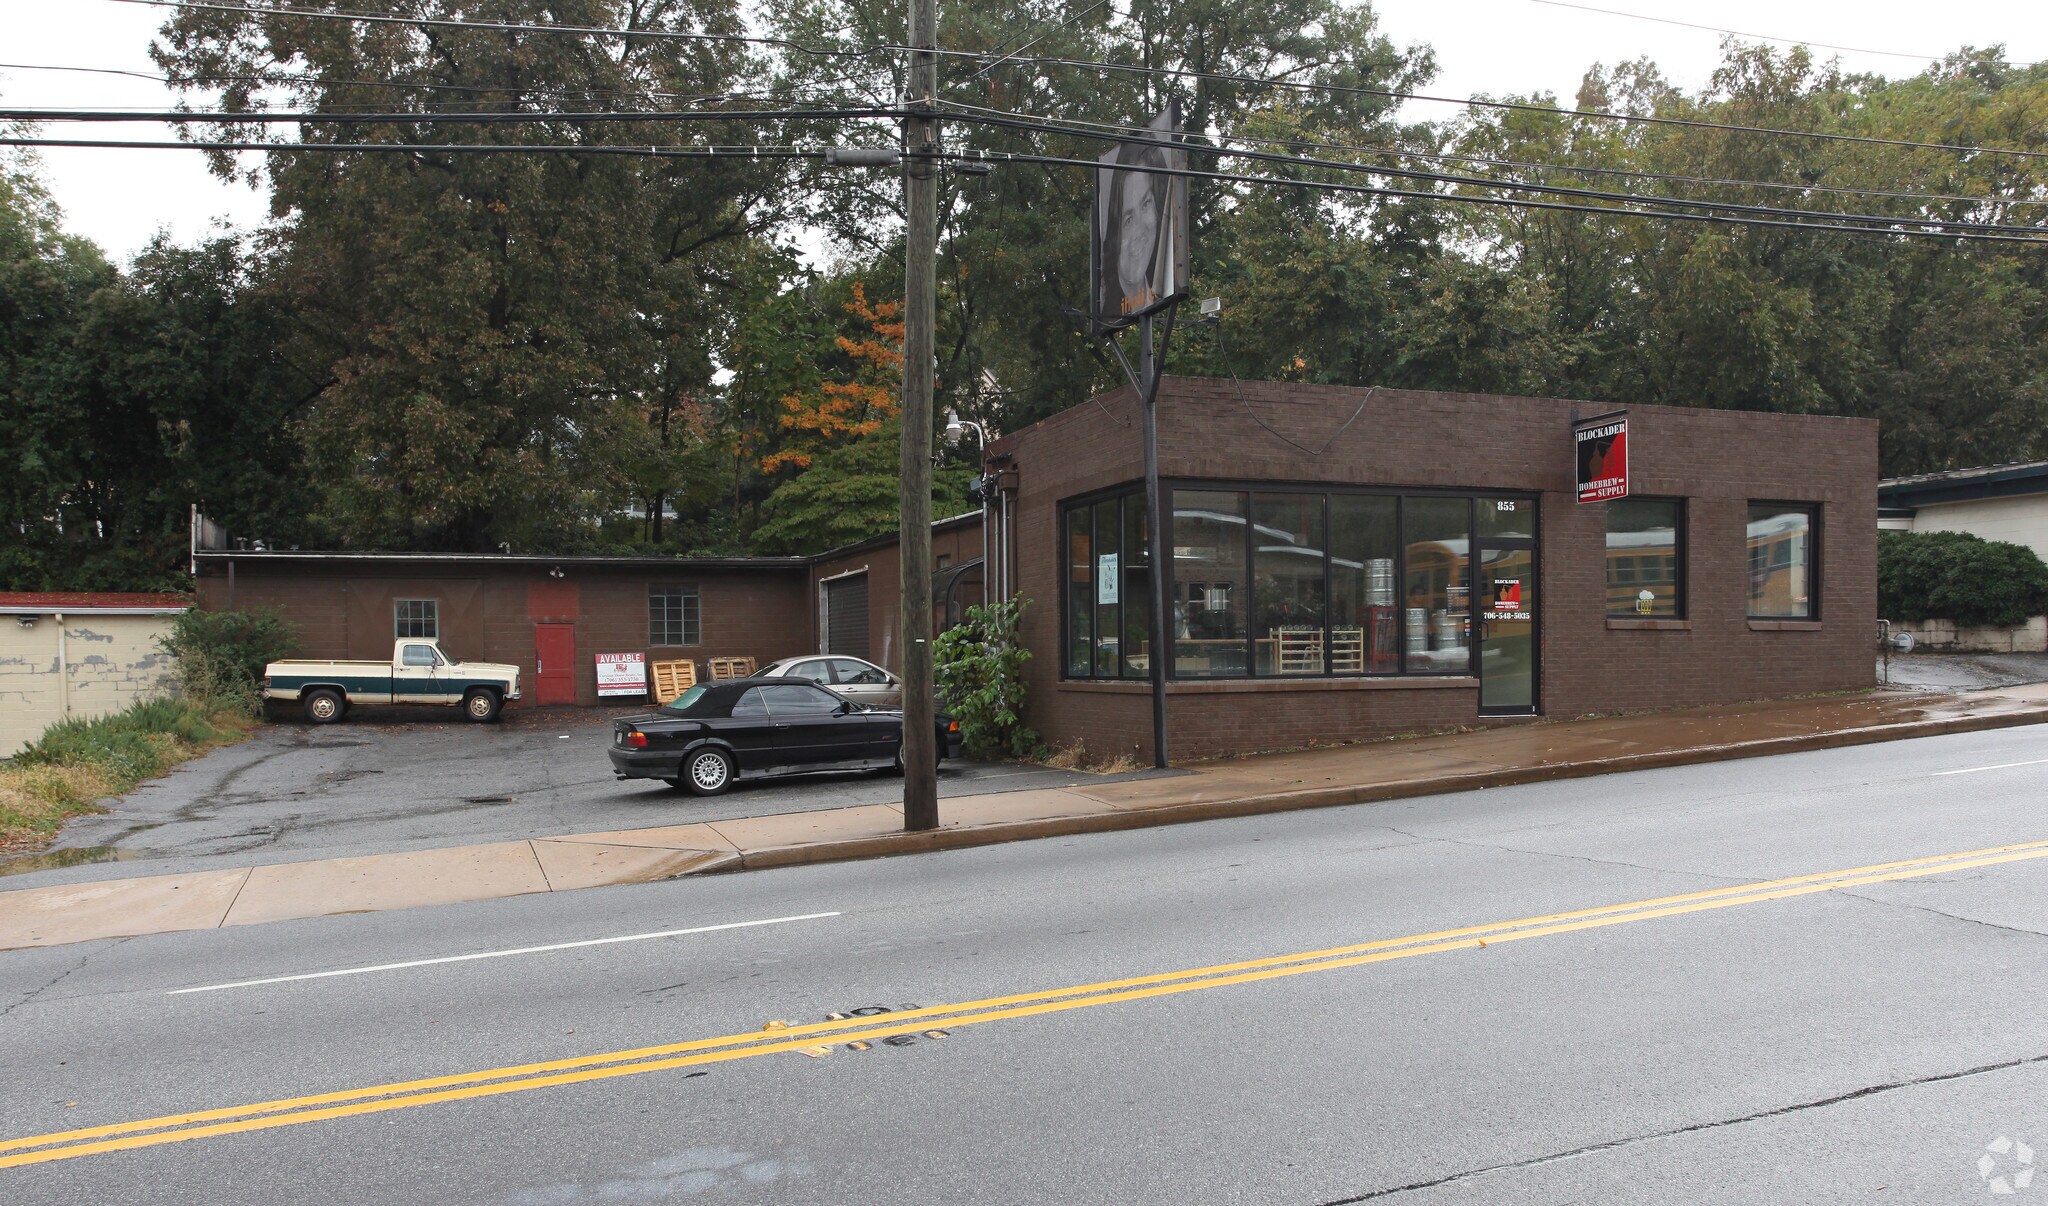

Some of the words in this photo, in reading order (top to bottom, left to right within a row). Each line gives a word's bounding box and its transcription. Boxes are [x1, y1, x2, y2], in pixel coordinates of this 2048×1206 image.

[1578, 423, 1625, 442] BLOCKADER
[1578, 477, 1619, 492] HOMEBREW
[1597, 485, 1625, 498] SUPPLY
[1497, 501, 1515, 512] 855
[1483, 612, 1530, 620] 706-548-5035
[600, 654, 641, 663] AVAILABLE
